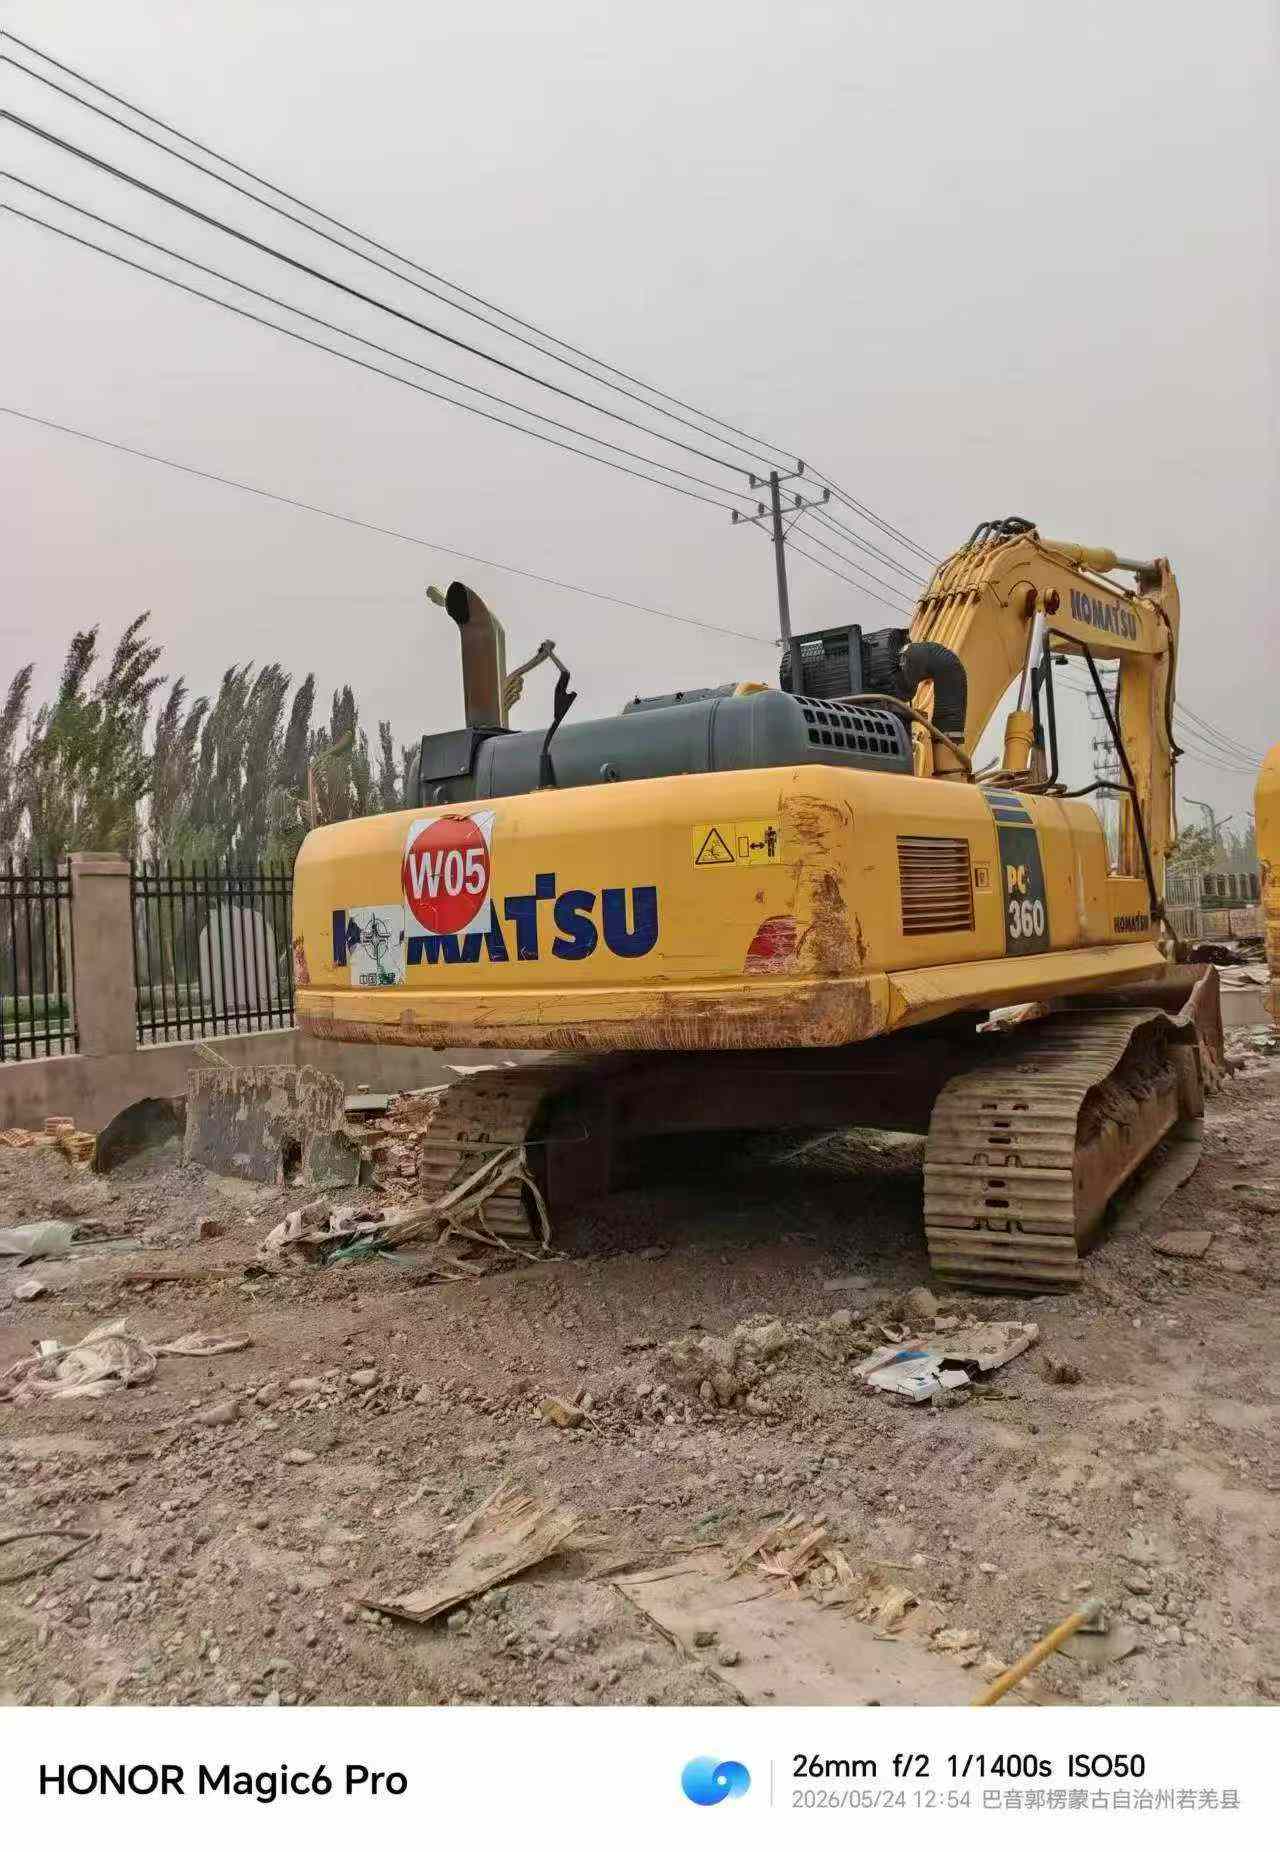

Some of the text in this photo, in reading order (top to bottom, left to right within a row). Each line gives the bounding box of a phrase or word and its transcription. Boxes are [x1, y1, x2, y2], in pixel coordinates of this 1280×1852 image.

[1070, 588, 1136, 641] KOMATSU
[408, 847, 486, 900] W05
[1009, 899, 1045, 938] 360
